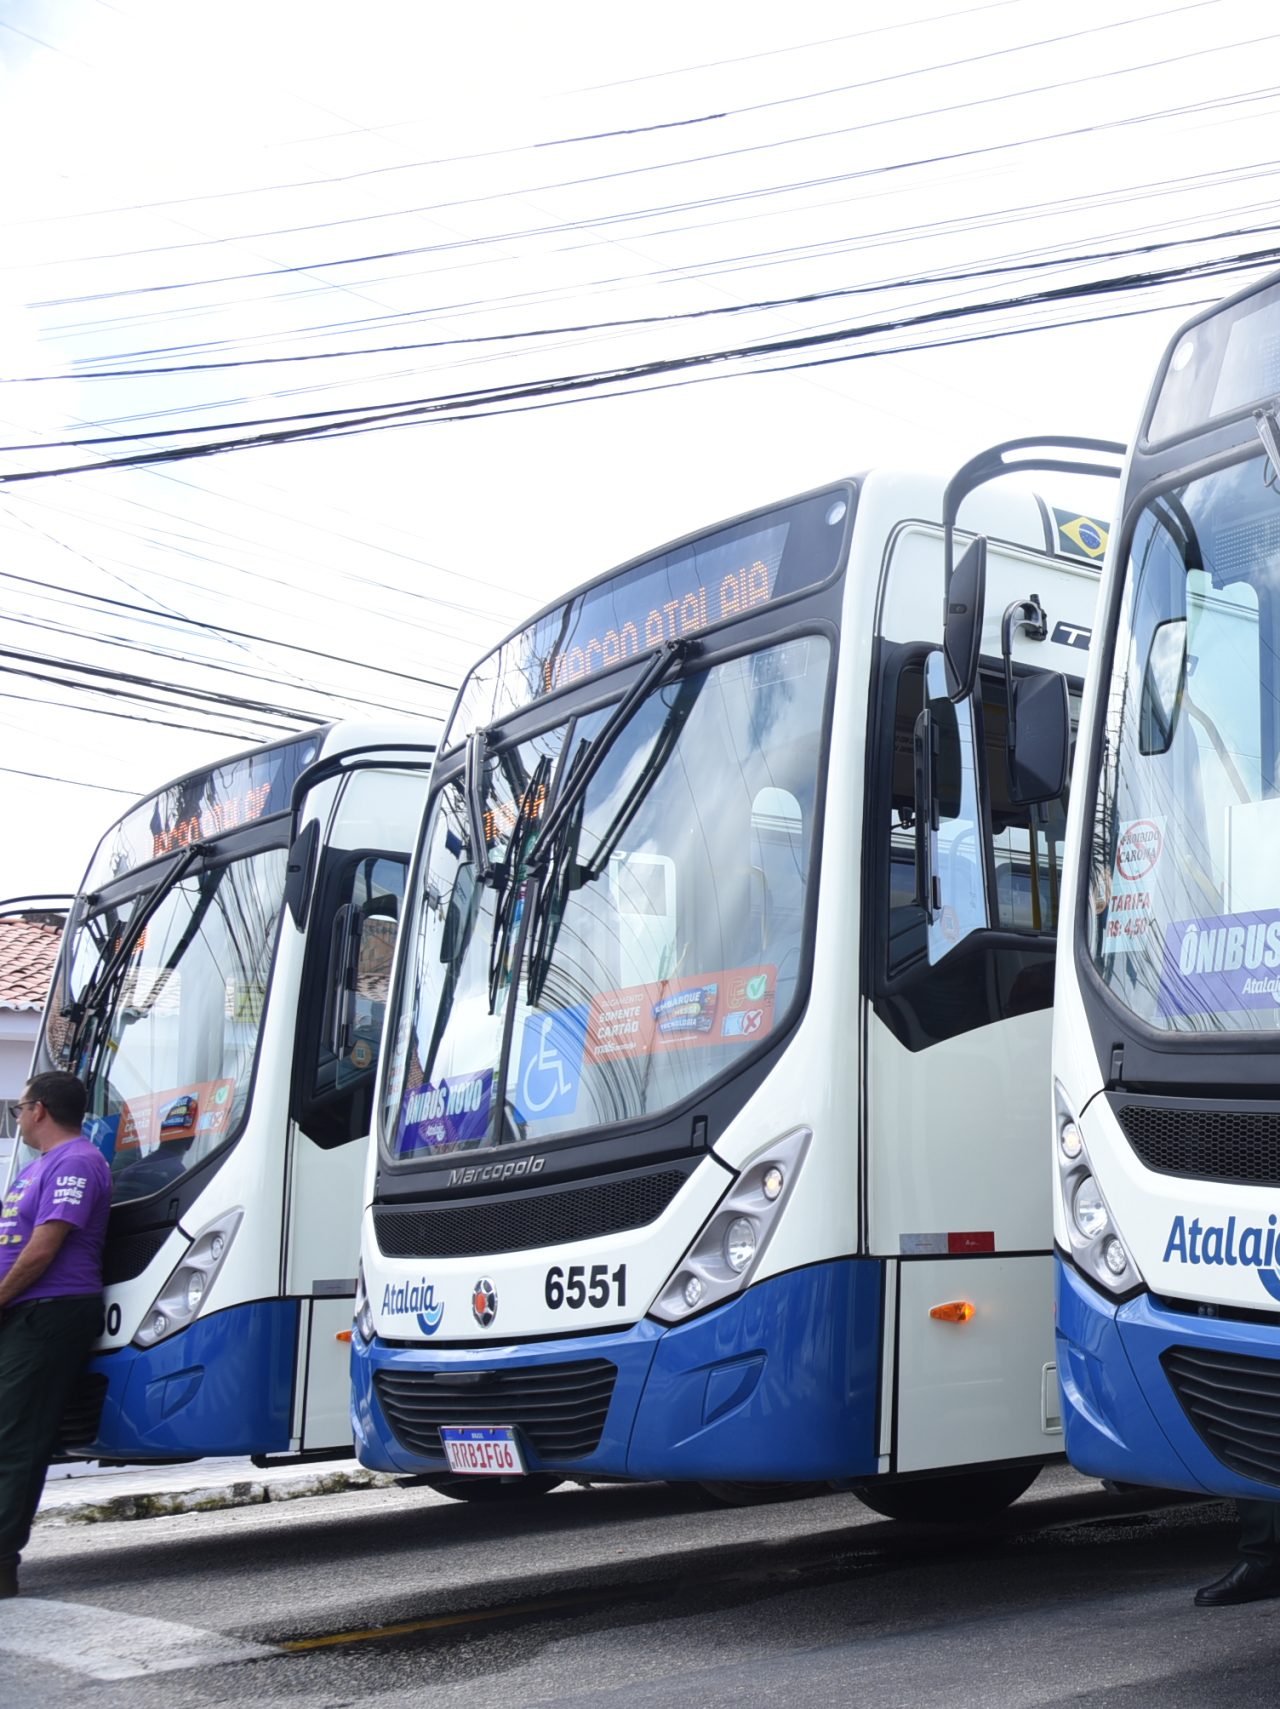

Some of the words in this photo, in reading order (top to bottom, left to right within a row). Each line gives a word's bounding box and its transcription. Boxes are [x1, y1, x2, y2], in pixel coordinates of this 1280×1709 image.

[1111, 892, 1150, 912] TARIFA
[1124, 917, 1147, 939] 4,50
[405, 1087, 447, 1126] ÔNIBUS
[446, 1078, 483, 1116] NOVO
[56, 1176, 87, 1189] USE
[447, 1155, 545, 1187] Marcopolo
[54, 1187, 83, 1199] mais
[381, 1276, 439, 1316] Atalaia
[545, 1264, 627, 1310] 6551
[451, 1443, 514, 1469] RRB1F06
